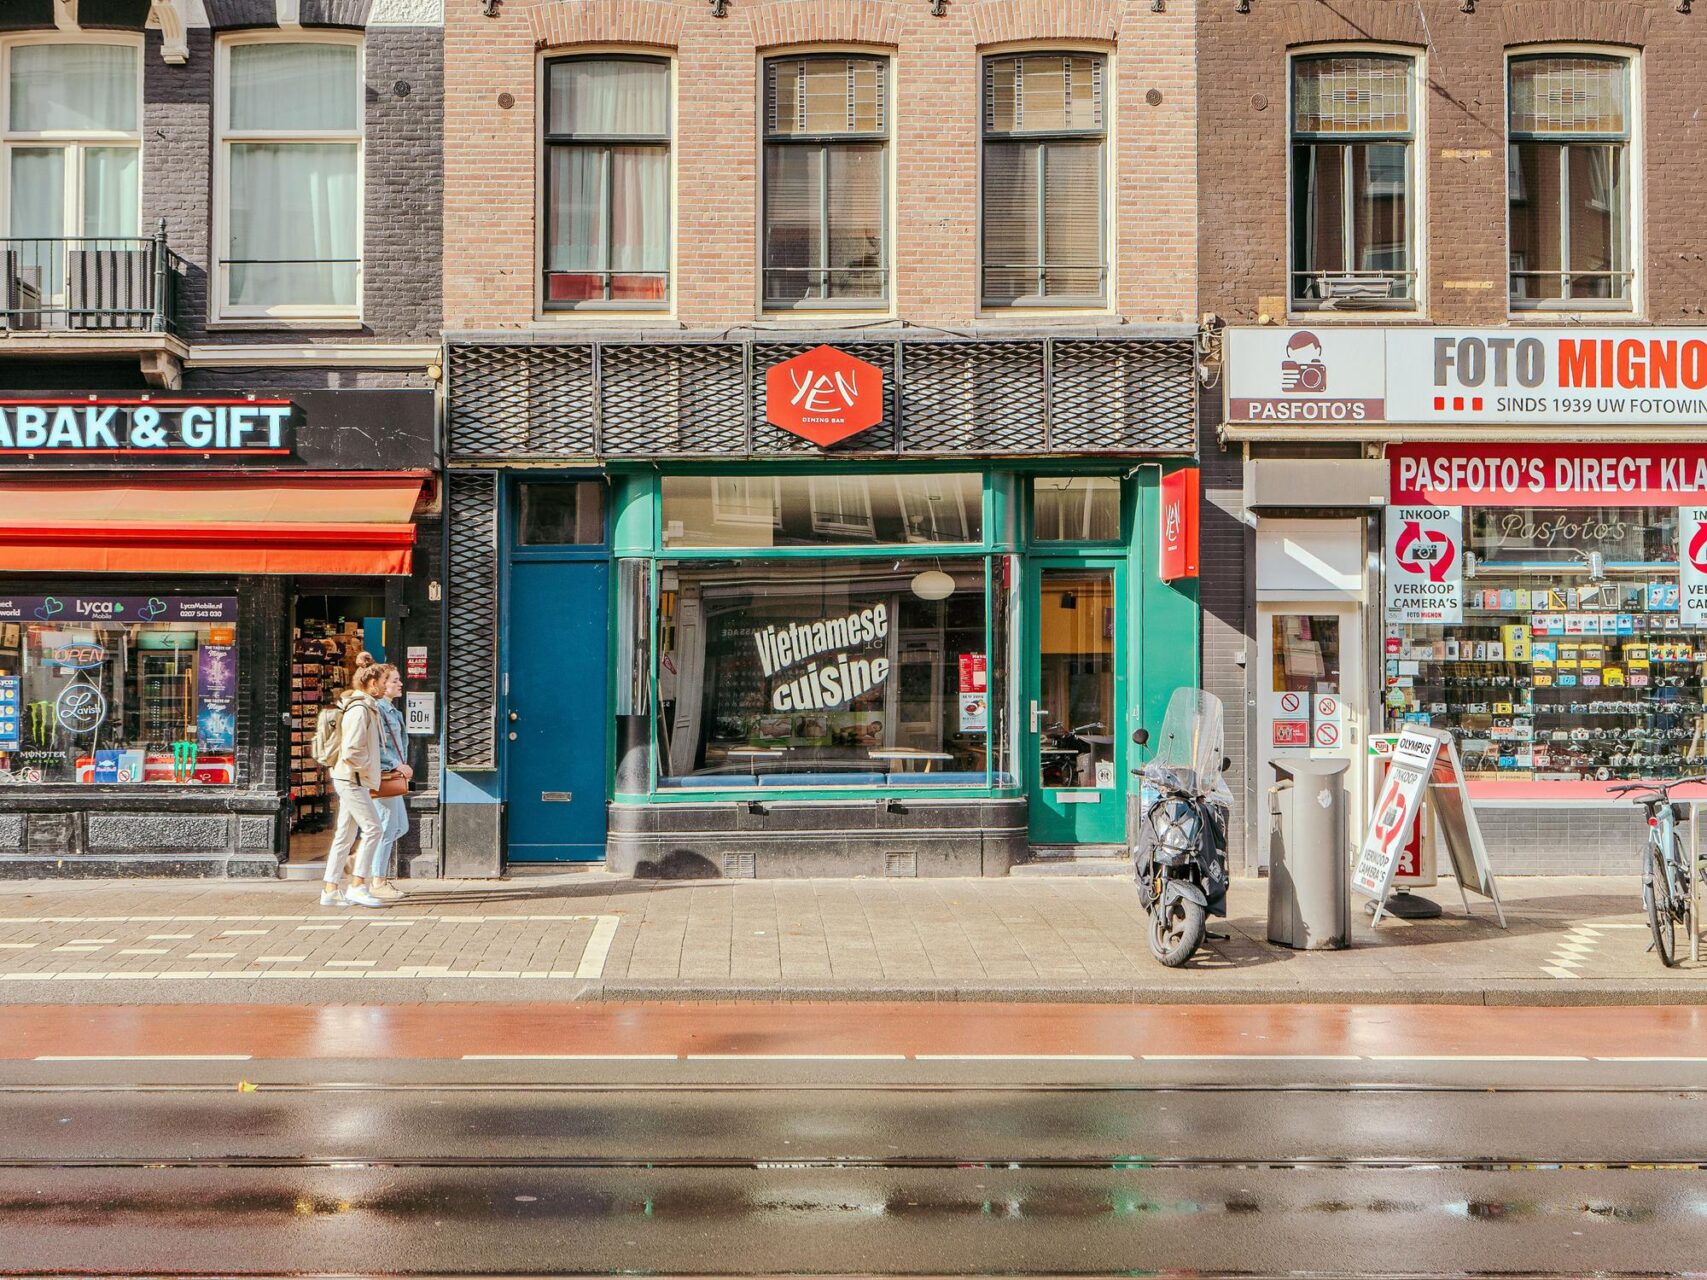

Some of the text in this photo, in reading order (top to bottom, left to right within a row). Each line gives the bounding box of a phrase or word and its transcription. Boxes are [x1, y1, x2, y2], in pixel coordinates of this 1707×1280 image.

[1433, 336, 1707, 390] FOTO MIGNO
[790, 368, 859, 413] YEN
[1248, 402, 1366, 419] PASFOTO'S
[1496, 397, 1547, 413] SINDS
[1552, 398, 1592, 413] 1939
[1596, 399, 1626, 413] UW
[130, 406, 169, 448] &
[180, 406, 292, 448] GIFT
[1400, 456, 1707, 493] PASFOTO'S DIRECT KLA
[1399, 509, 1451, 520] INKOOP
[1499, 514, 1627, 547] Pasfoto's
[1394, 583, 1455, 595] VERKOOP
[1687, 584, 1707, 595] VE
[76, 599, 113, 616] Lyca
[1393, 598, 1458, 609] CAMERA'S
[1687, 598, 1707, 609] CA
[754, 603, 889, 678] Vietnamese
[54, 648, 105, 662] OPEN
[773, 653, 890, 711] cuisine
[60, 692, 101, 721] Lavish
[410, 710, 423, 723] 60
[1399, 738, 1432, 755] OLYMPUS
